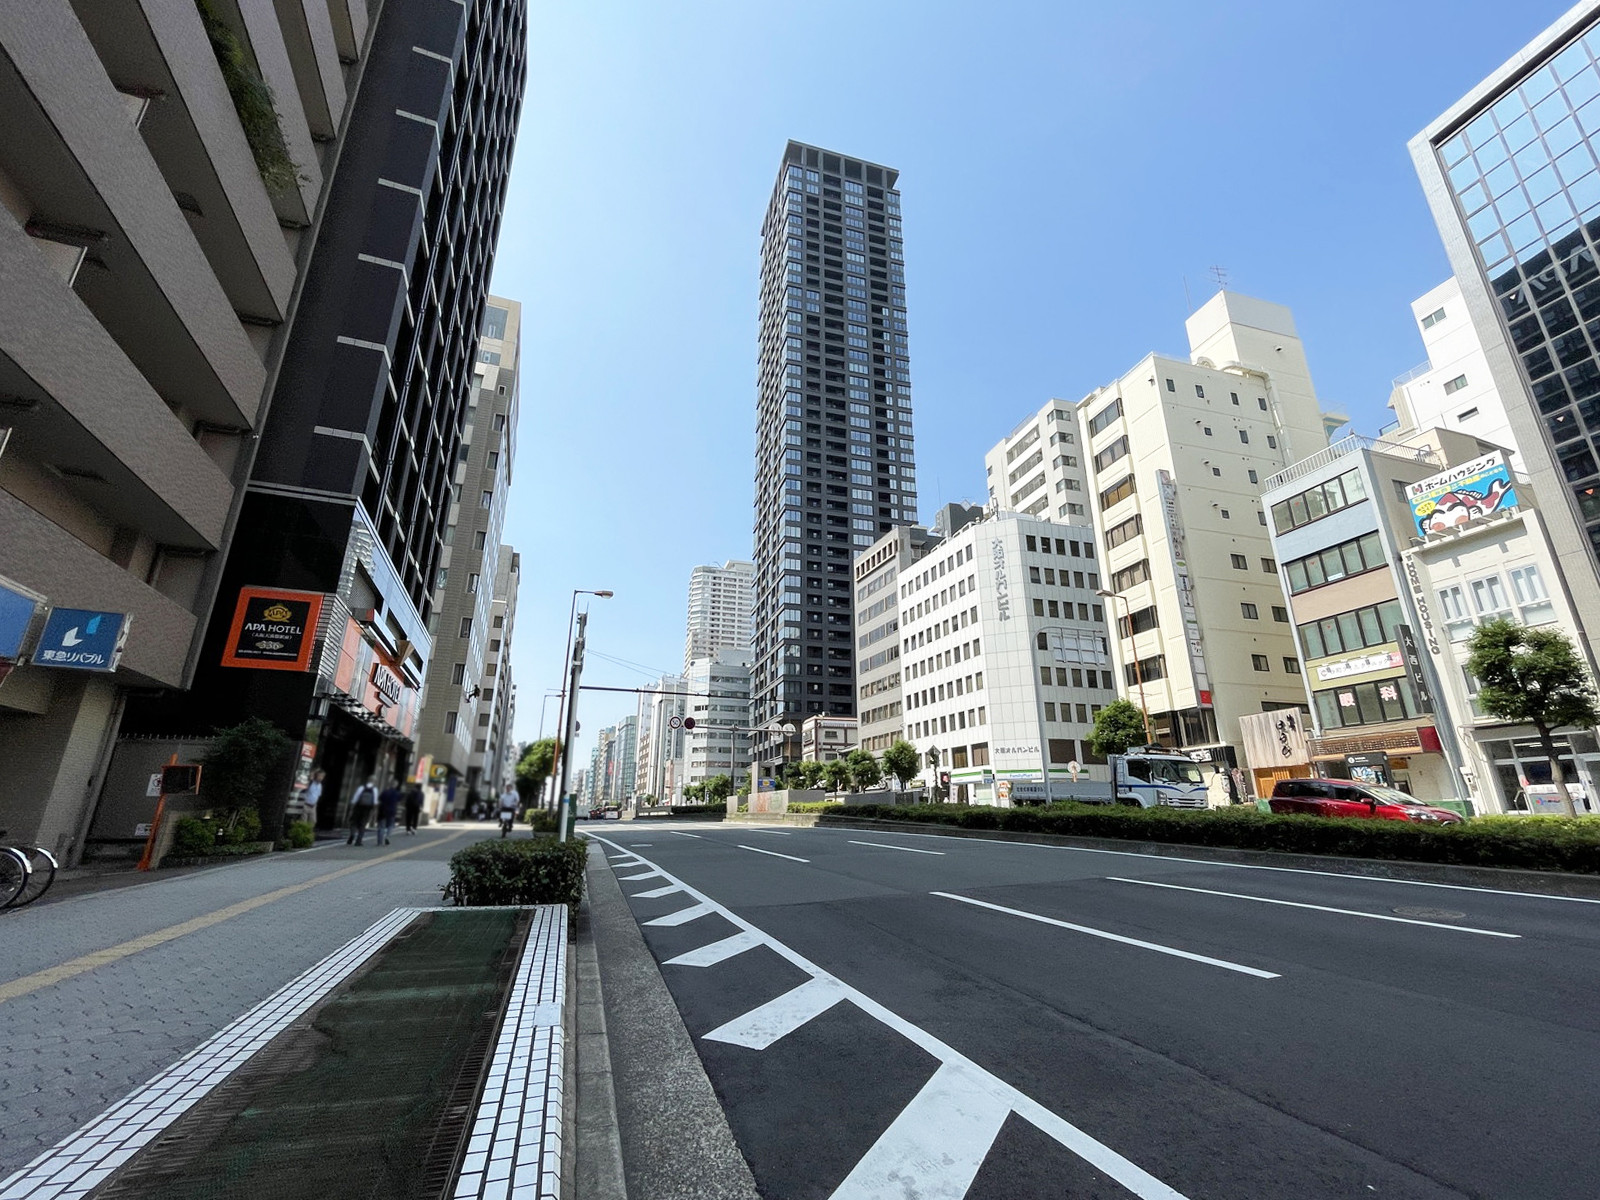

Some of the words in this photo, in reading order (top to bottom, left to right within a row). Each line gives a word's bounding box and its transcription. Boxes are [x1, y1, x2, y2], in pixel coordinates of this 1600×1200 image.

[1425, 456, 1496, 491] ホームハウジング
[1406, 561, 1423, 595] HOME
[1416, 596, 1441, 656] HOUSING
[244, 622, 266, 632] APA
[267, 625, 302, 635] HOTEL
[41, 649, 105, 665] 東急リバブル
